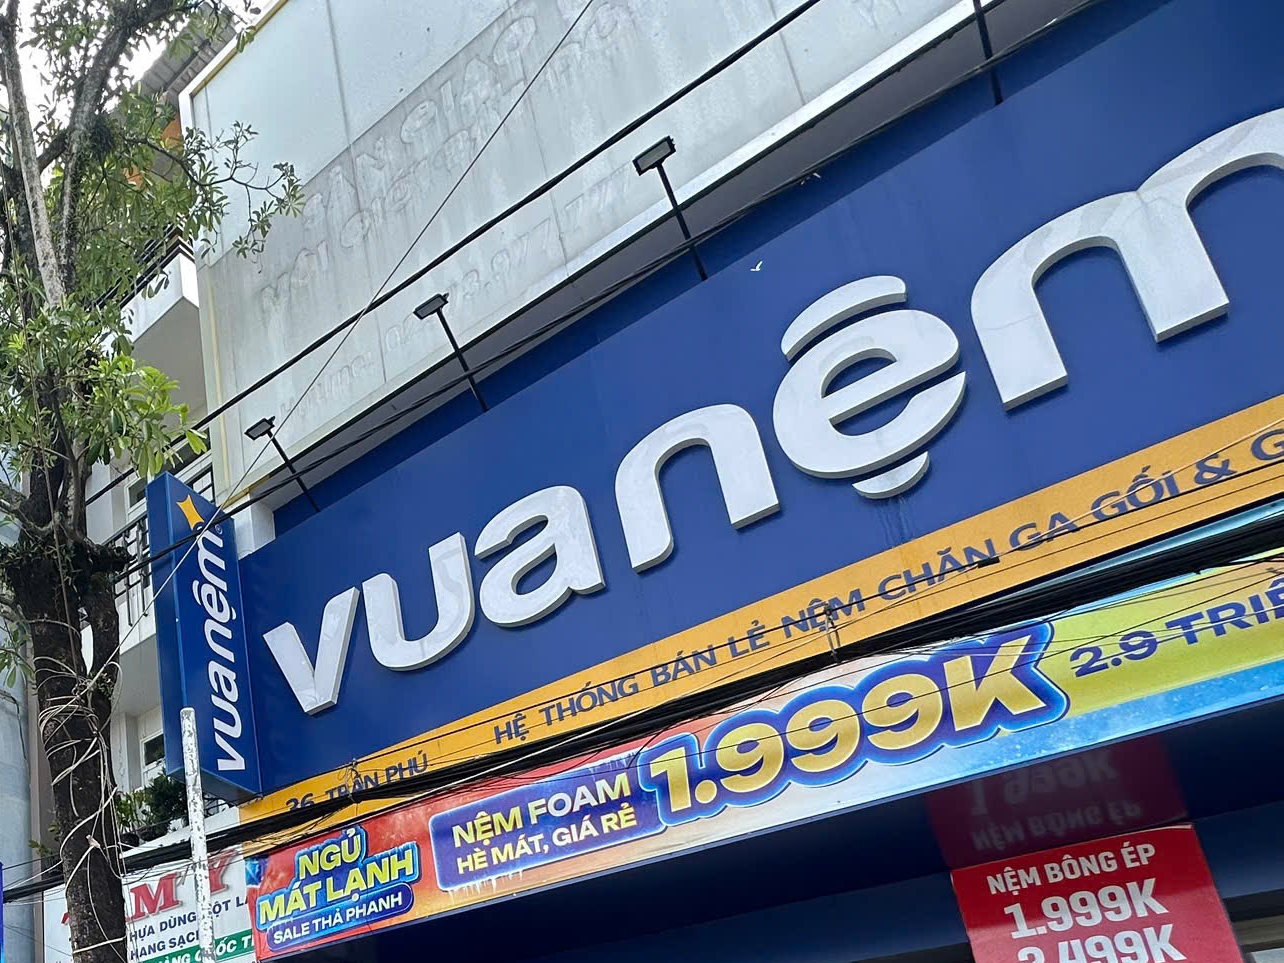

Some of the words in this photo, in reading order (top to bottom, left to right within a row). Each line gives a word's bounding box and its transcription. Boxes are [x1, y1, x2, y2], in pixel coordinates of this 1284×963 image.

[493, 713, 528, 744] HỆ
[650, 644, 717, 687] BÁN
[727, 621, 770, 657] LẺ
[781, 590, 865, 639] NỆM
[878, 538, 1000, 600] CHĂN
[1009, 511, 1078, 552] GA
[1091, 466, 1180, 521] GỐI
[1193, 454, 1236, 486] &
[1070, 631, 1157, 677] 2.9
[649, 632, 1048, 813] 1.999K
[386, 750, 427, 783] PHÚ
[452, 806, 524, 847] NỆM
[527, 774, 631, 824] FOAM
[457, 853, 488, 874] HÈ
[491, 836, 549, 865] MÁT,
[556, 816, 596, 848] GIÁ
[601, 802, 637, 833] RẺ
[297, 828, 362, 880] NGỦ
[987, 867, 1041, 896] NỆM
[1044, 854, 1118, 884] BÔNG
[1121, 841, 1156, 868] ÉP
[258, 882, 323, 922] MÁT
[325, 848, 415, 901] LẠNH
[1004, 878, 1169, 939] 1.999K
[272, 921, 310, 944] SALE
[311, 907, 345, 933] THẢ
[345, 892, 402, 922] PHANH
